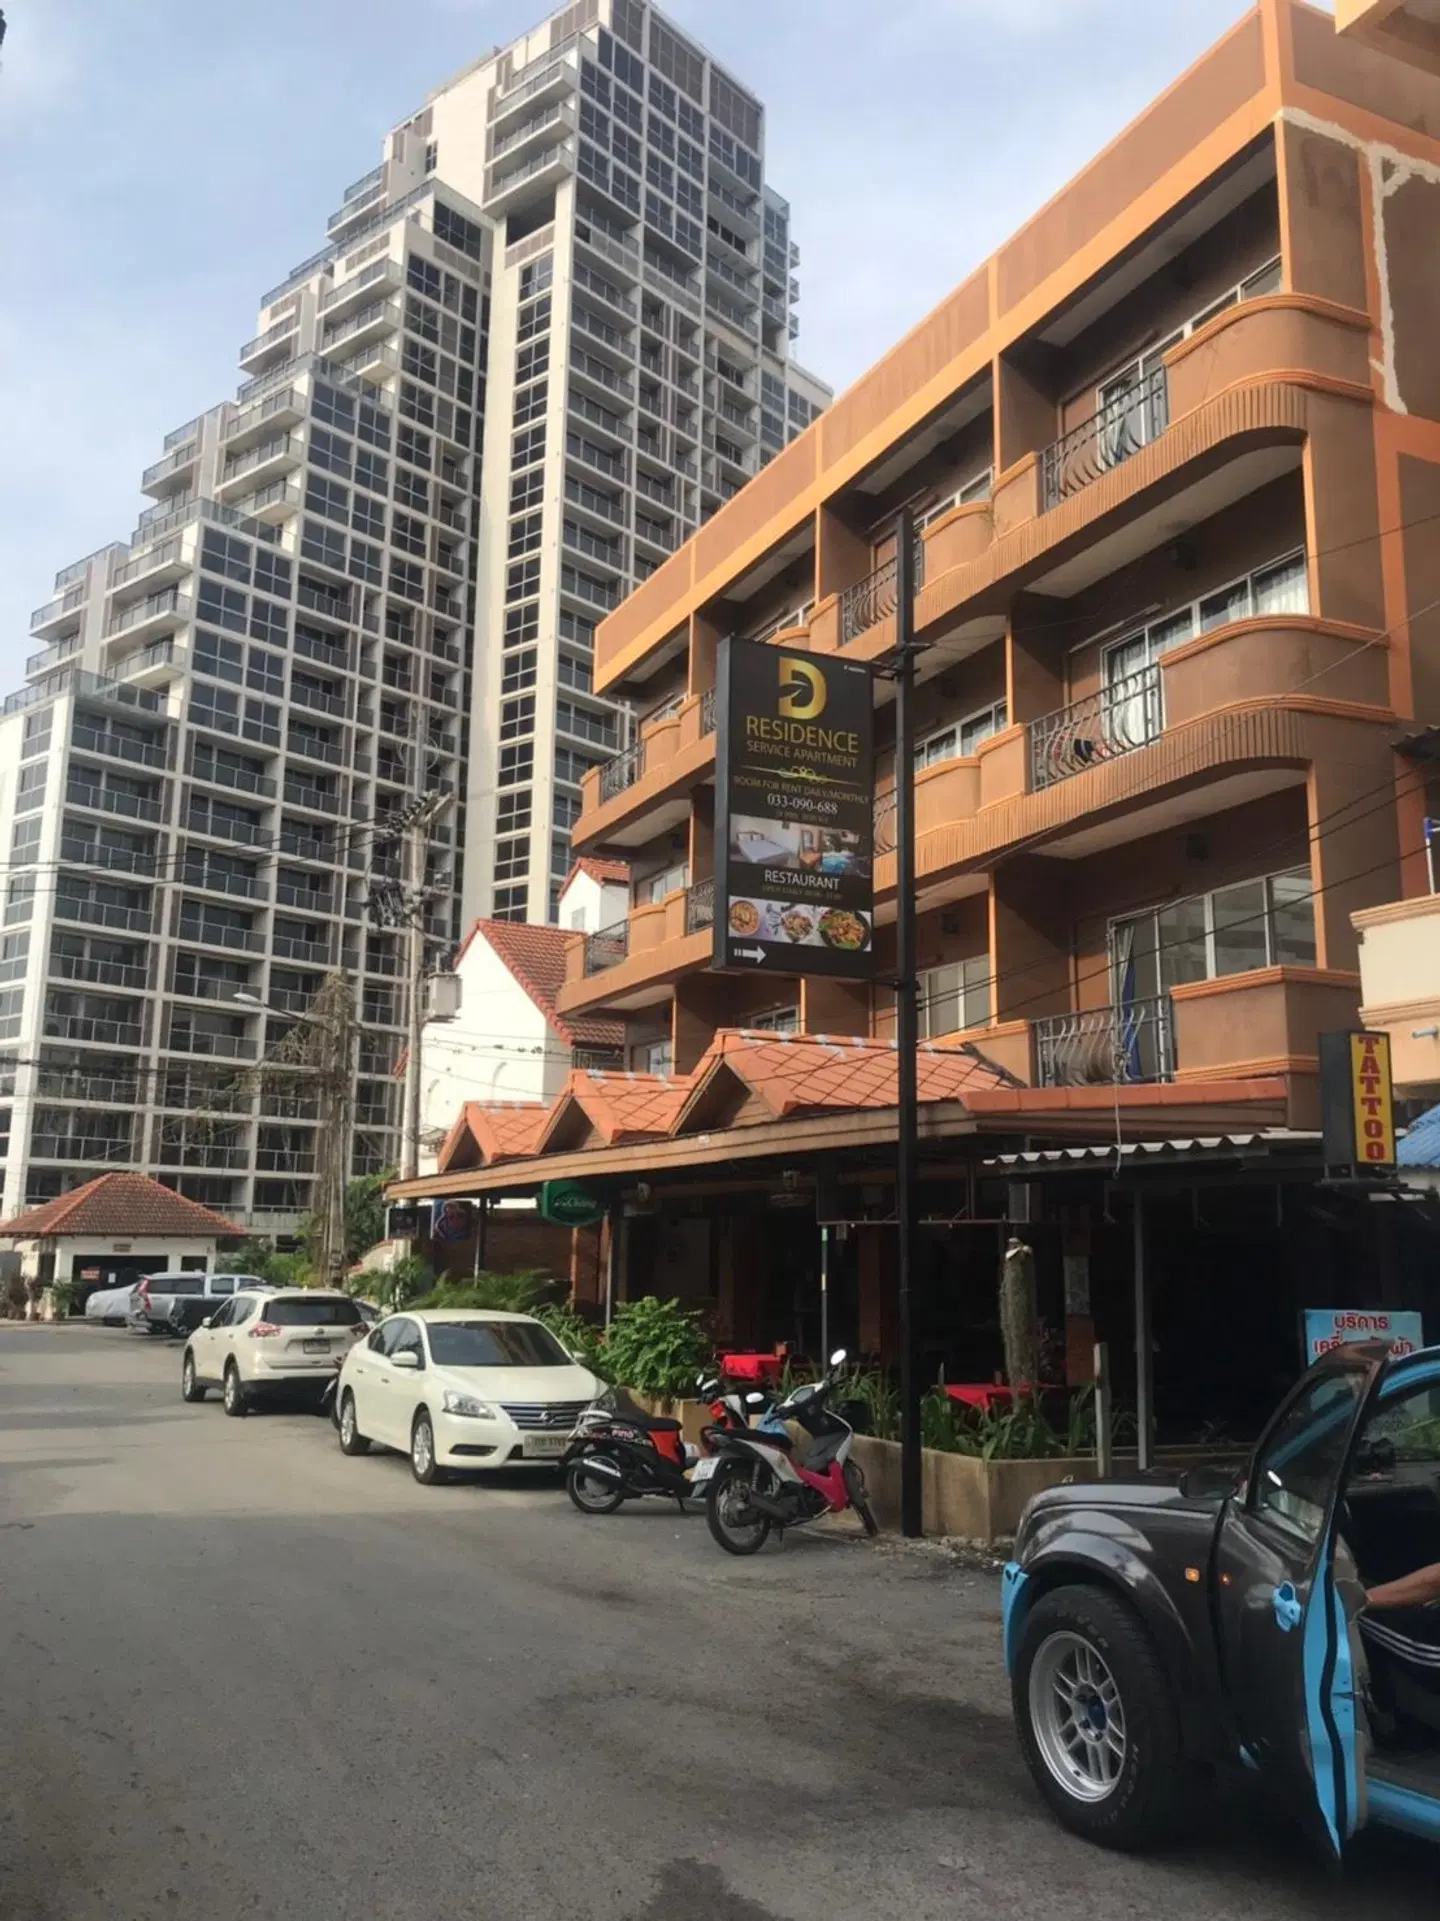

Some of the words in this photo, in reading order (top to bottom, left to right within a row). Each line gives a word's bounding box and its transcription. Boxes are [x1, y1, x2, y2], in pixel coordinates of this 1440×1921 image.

[746, 715, 859, 753] RESIDENCE
[746, 740, 790, 758] SERVICE
[794, 749, 858, 768] APARTMENT
[733, 775, 761, 788] ROOM
[762, 779, 780, 790] FOR
[781, 782, 802, 794] RENT
[767, 792, 839, 815] 033-090-688
[764, 869, 841, 891] RESTAURANT
[1357, 1036, 1386, 1161] TATTOO
[1334, 1312, 1389, 1330] บริการ
